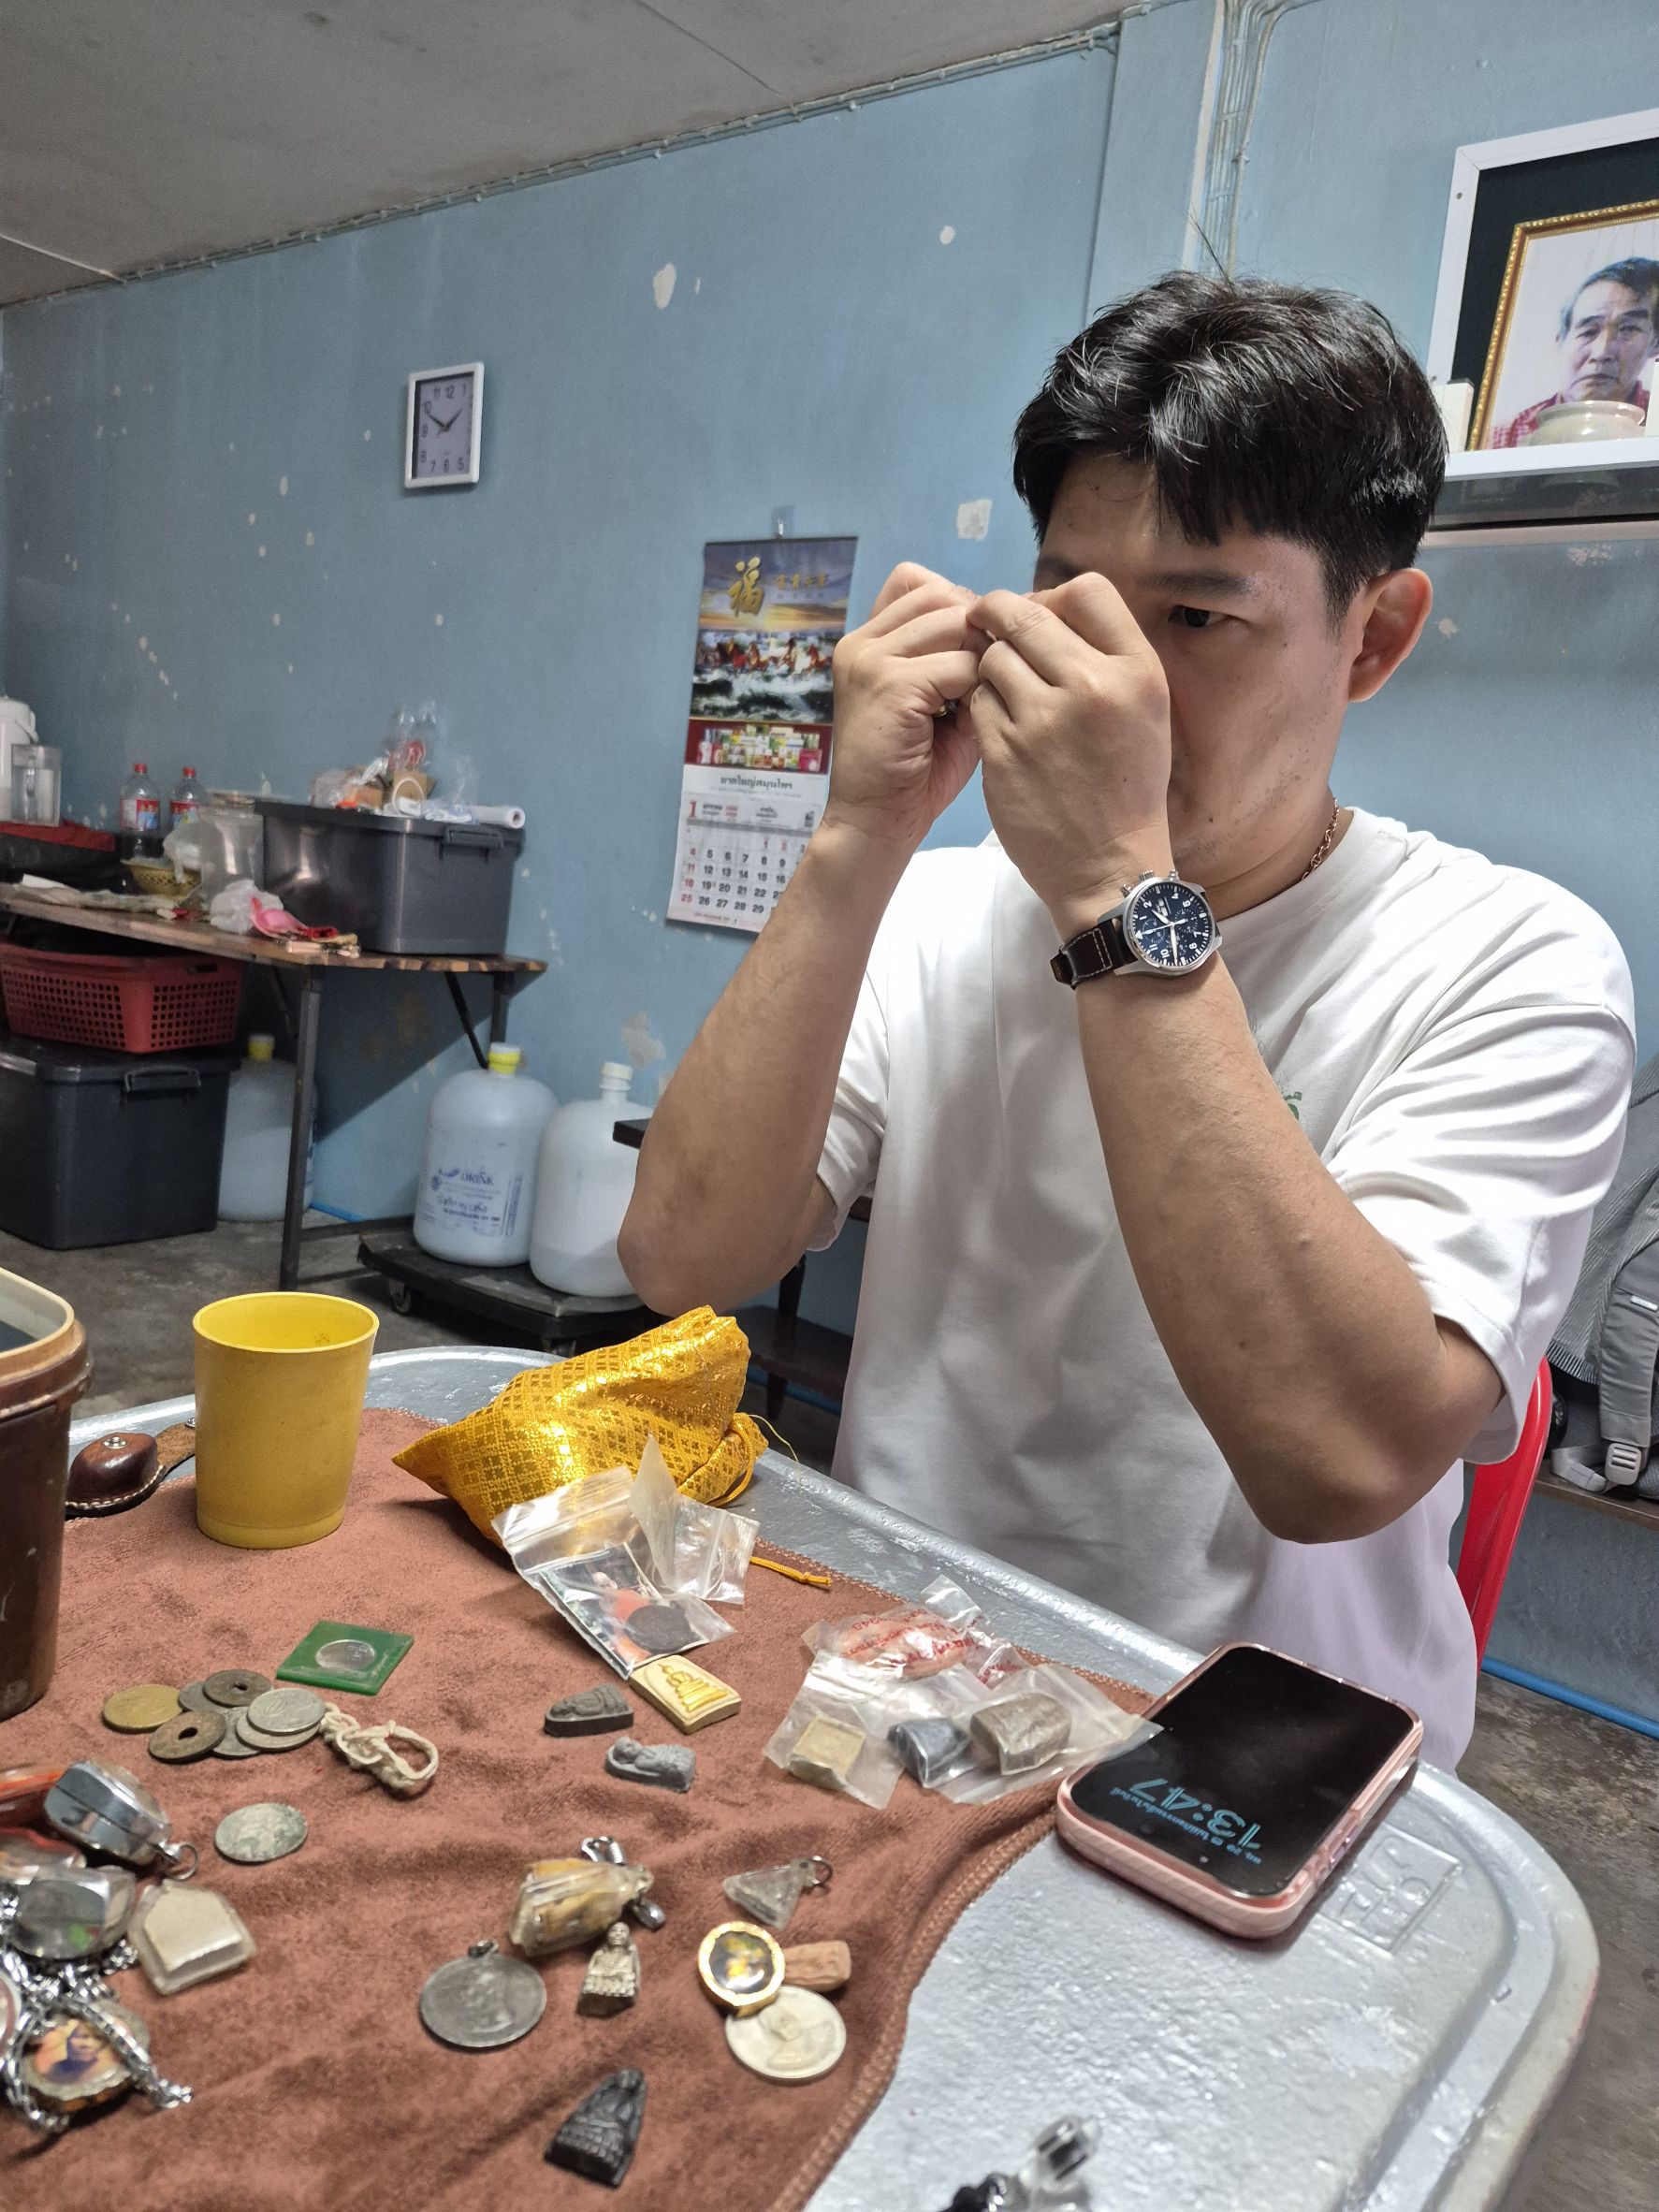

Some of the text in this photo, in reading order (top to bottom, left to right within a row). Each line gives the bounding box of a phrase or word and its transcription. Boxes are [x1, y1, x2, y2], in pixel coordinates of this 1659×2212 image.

[444, 386, 455, 399] 12
[727, 556, 765, 618] 福
[689, 800, 697, 818] 1
[706, 849, 713, 858] 5
[724, 851, 732, 861] 6
[742, 853, 749, 863] 7
[761, 856, 767, 866] 8
[779, 859, 786, 868] 9
[687, 864, 786, 884] 11 12 13 14 15 16
[685, 879, 694, 888] 18
[702, 880, 712, 890] 19
[719, 883, 731, 893] 20
[737, 885, 747, 895] 21
[754, 888, 766, 897] 22
[681, 894, 764, 914] 25 26 27 28 29
[1142, 900, 1153, 909] 2
[1182, 899, 1191, 908] 5
[1149, 943, 1158, 952] 11
[1160, 948, 1171, 958] 10
[1128, 1778, 1261, 1849] 13:47
